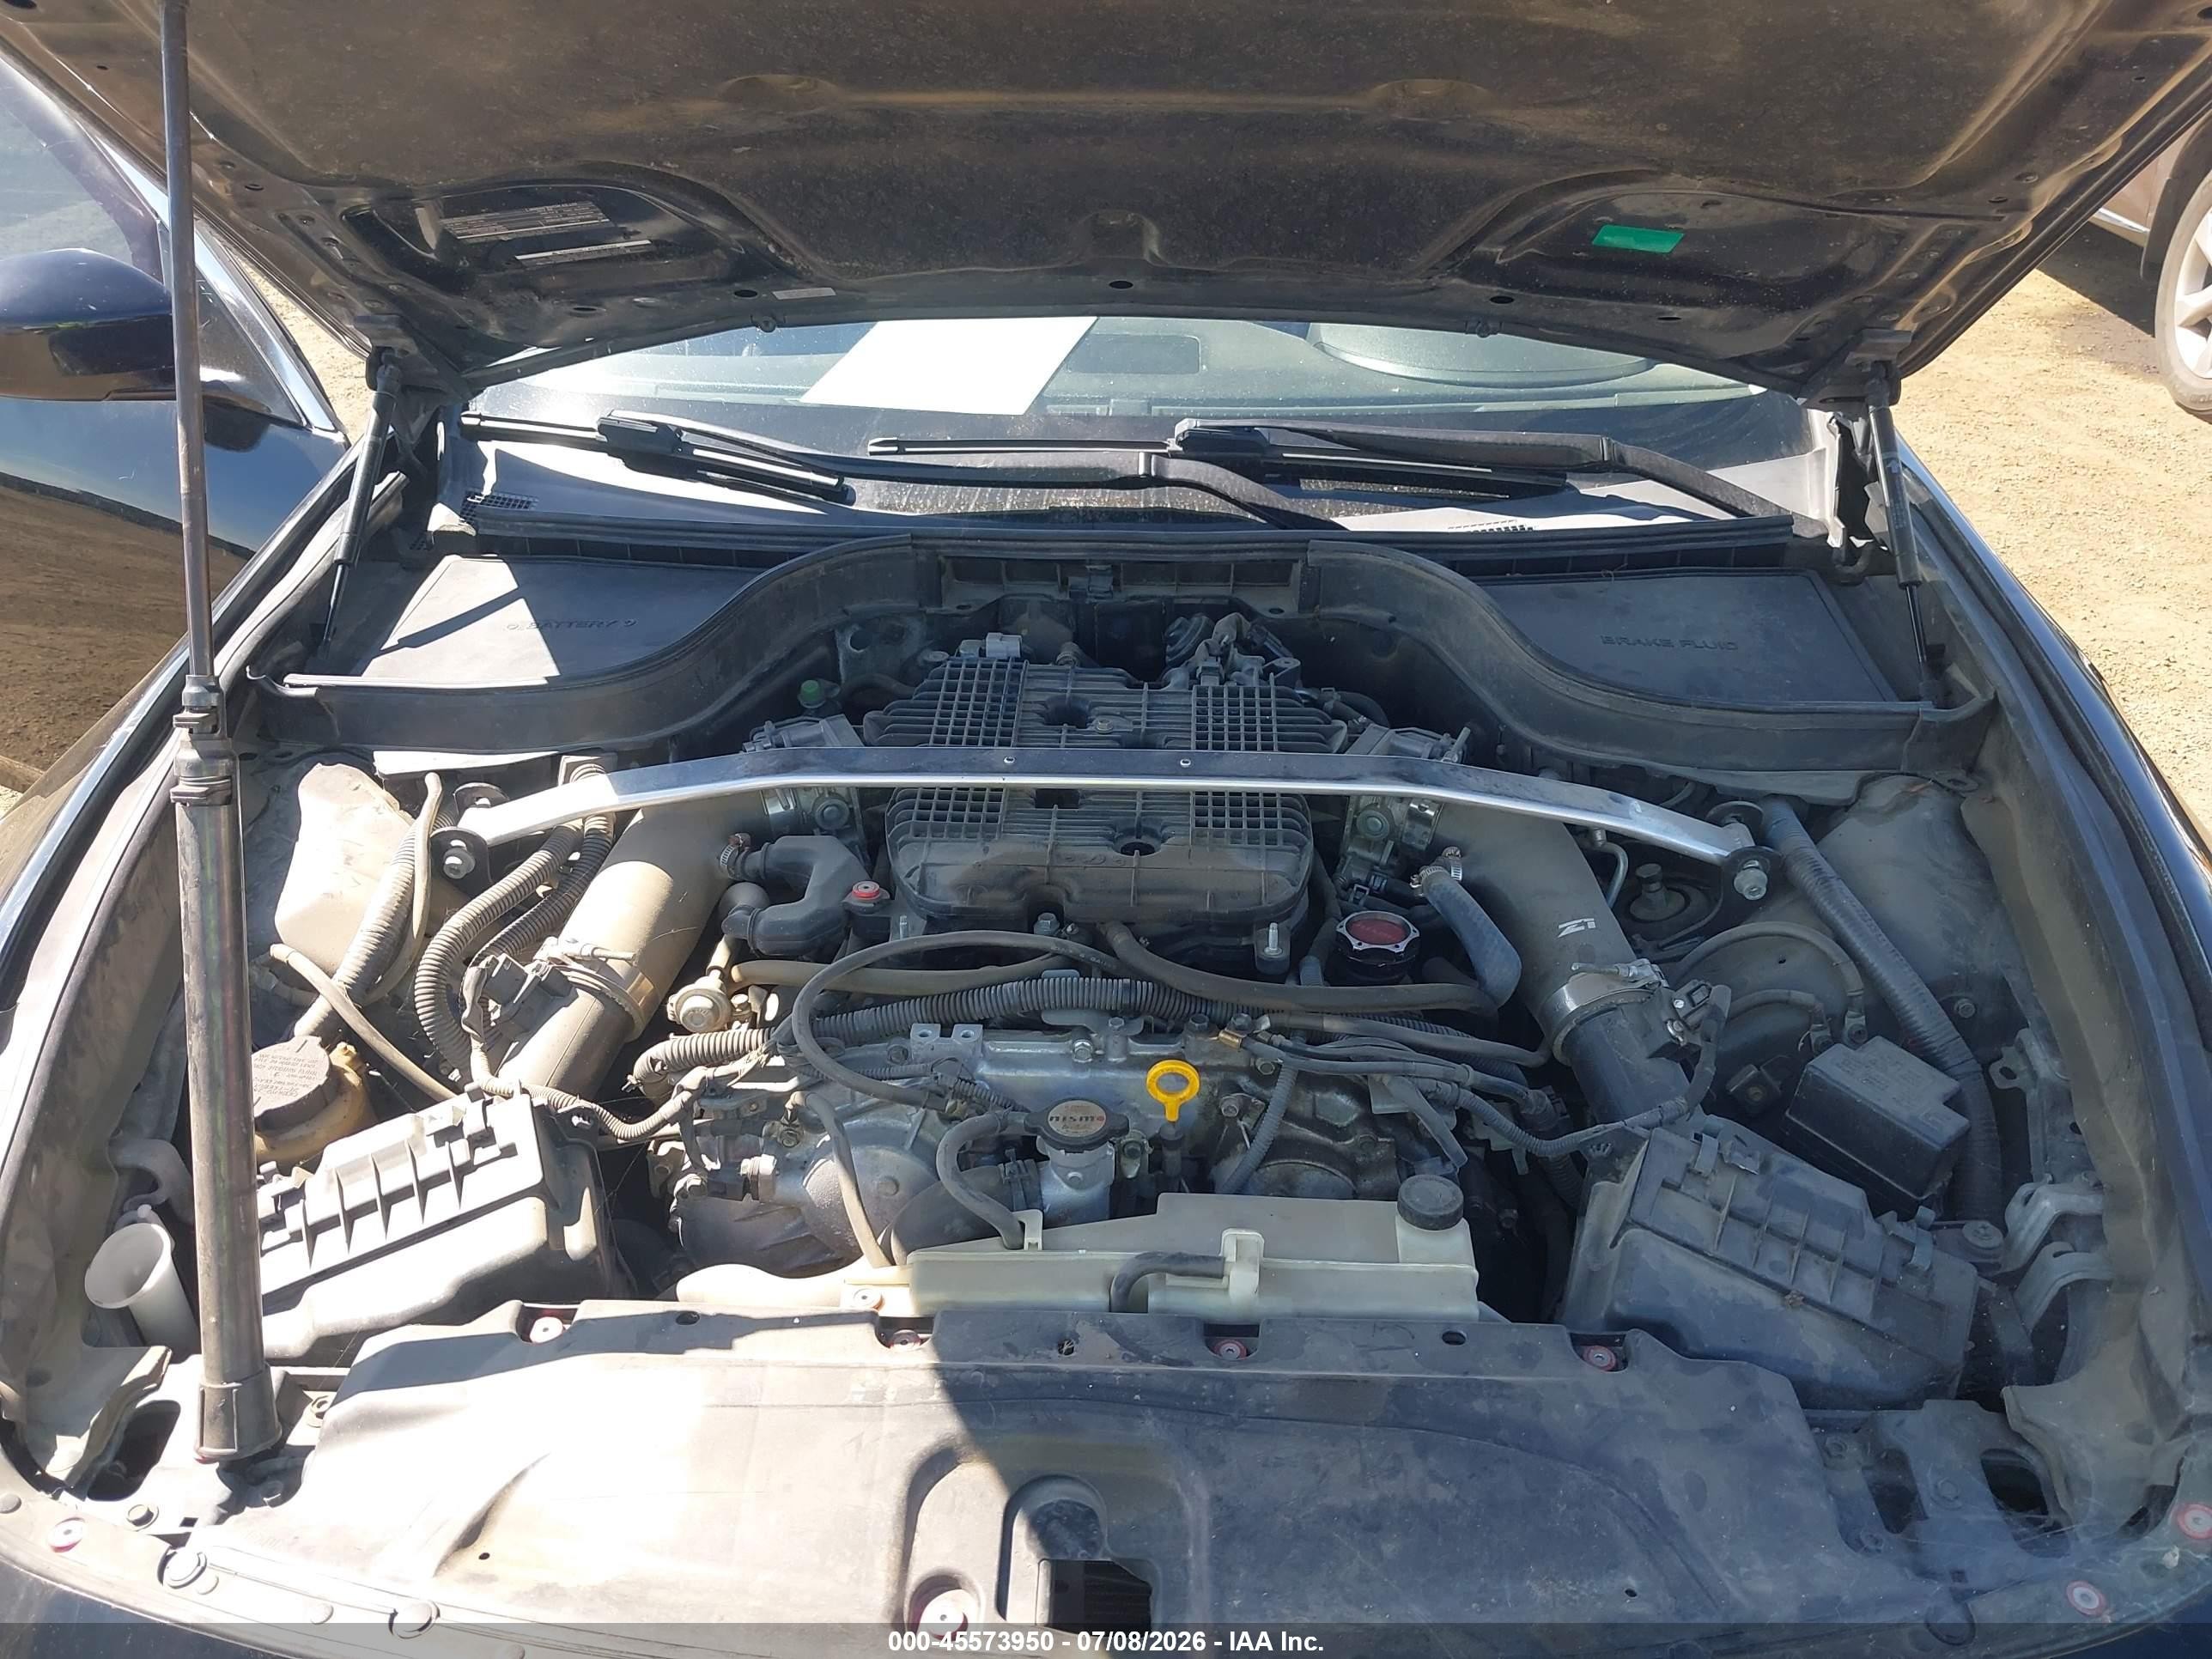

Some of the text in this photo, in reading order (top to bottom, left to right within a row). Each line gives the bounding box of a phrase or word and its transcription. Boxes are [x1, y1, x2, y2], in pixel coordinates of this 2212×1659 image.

[526, 617, 619, 630] BATTERY
[1600, 635, 1739, 651] BRAKE FLUID
